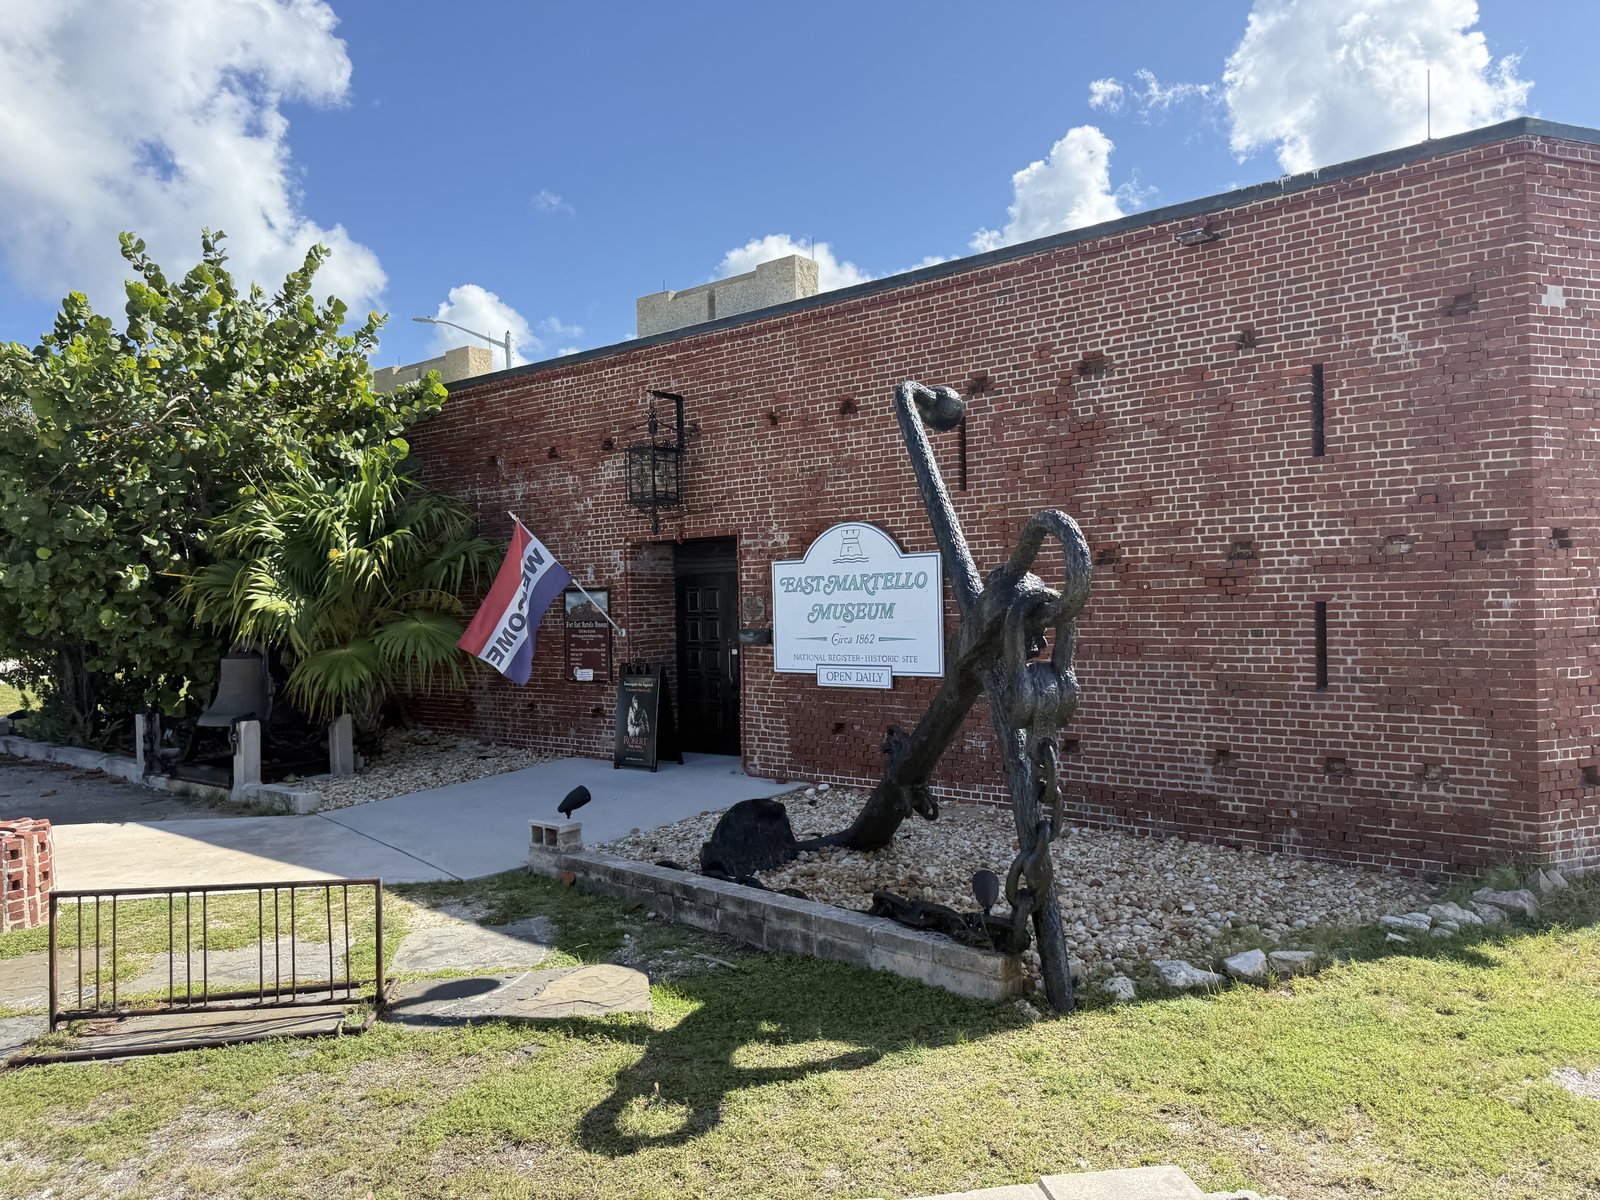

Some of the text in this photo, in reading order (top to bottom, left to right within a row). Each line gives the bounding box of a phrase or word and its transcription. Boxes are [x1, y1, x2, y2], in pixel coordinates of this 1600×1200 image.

[780, 571, 928, 596] EAST MARTELLO
[807, 602, 896, 623] MUSEUM
[831, 632, 876, 646] Circa 1862
[793, 653, 826, 661] NATIONAL
[902, 655, 918, 663] SITE
[826, 671, 884, 683] OPEN DAILY
